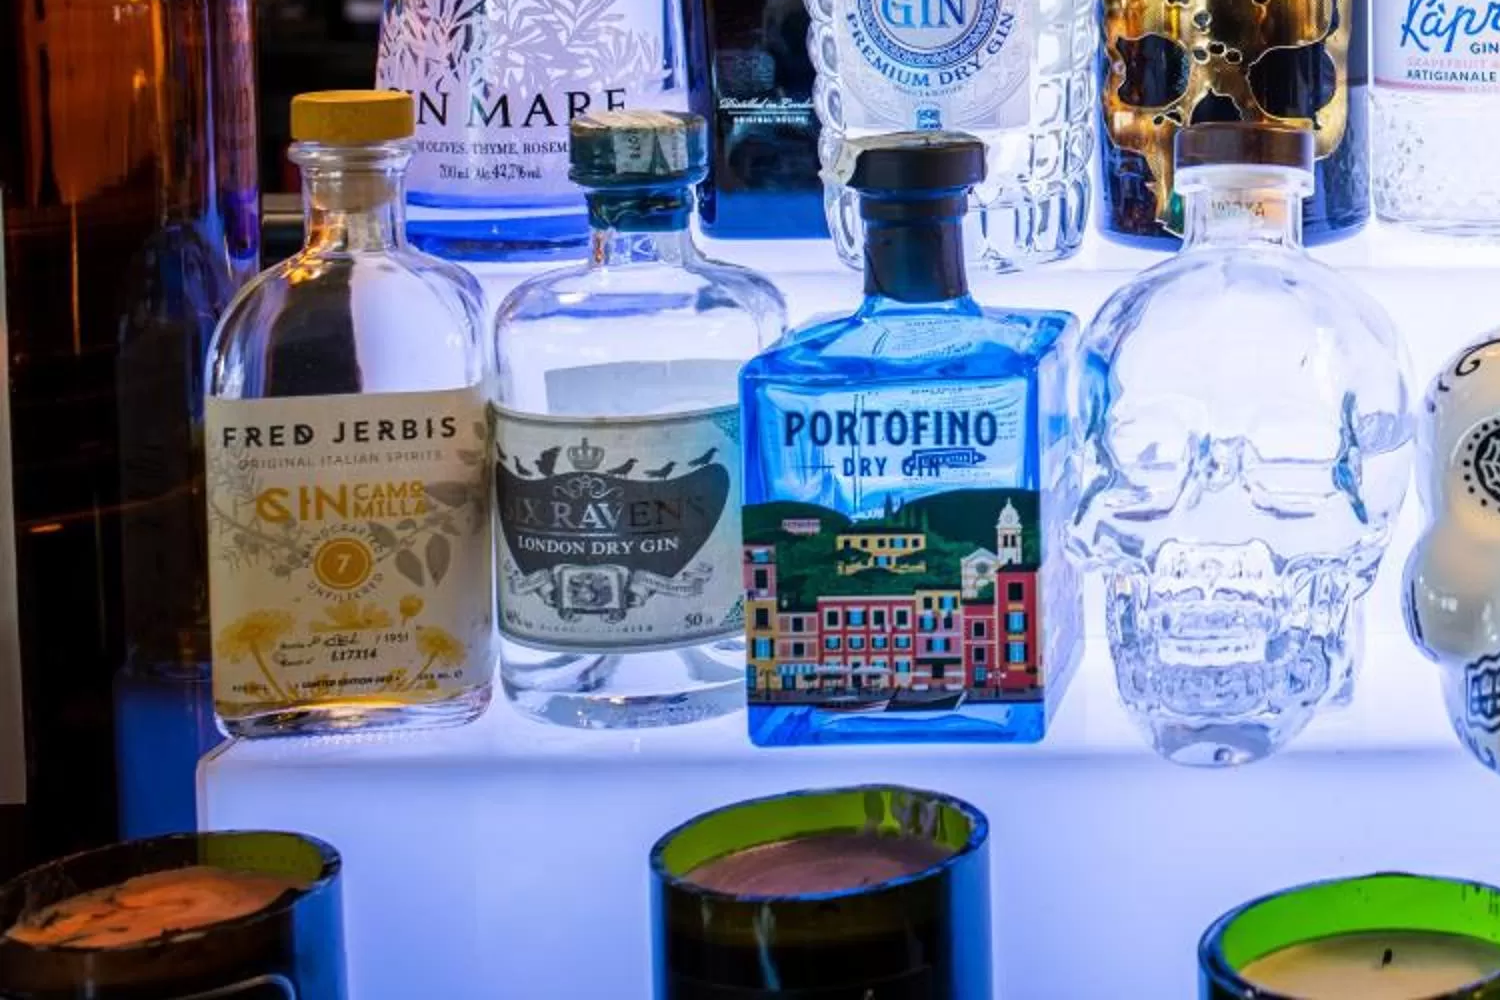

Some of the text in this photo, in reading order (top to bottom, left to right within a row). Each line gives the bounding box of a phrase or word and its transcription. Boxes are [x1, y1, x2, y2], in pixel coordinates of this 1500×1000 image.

[845, 11, 1016, 87] PREMIUM DRY GIN
[1468, 41, 1500, 55] GIN
[1406, 69, 1498, 83] ARTIGIANALE
[223, 416, 457, 448] FRED JERBIS
[783, 410, 998, 448] PORTOFINO
[237, 449, 443, 471] ORIGINAL ITALIAN SPIRITS
[843, 457, 888, 478] DRY
[255, 482, 348, 523] GIN
[517, 535, 680, 555] LONDON DRY GIN
[337, 553, 353, 575] 7
